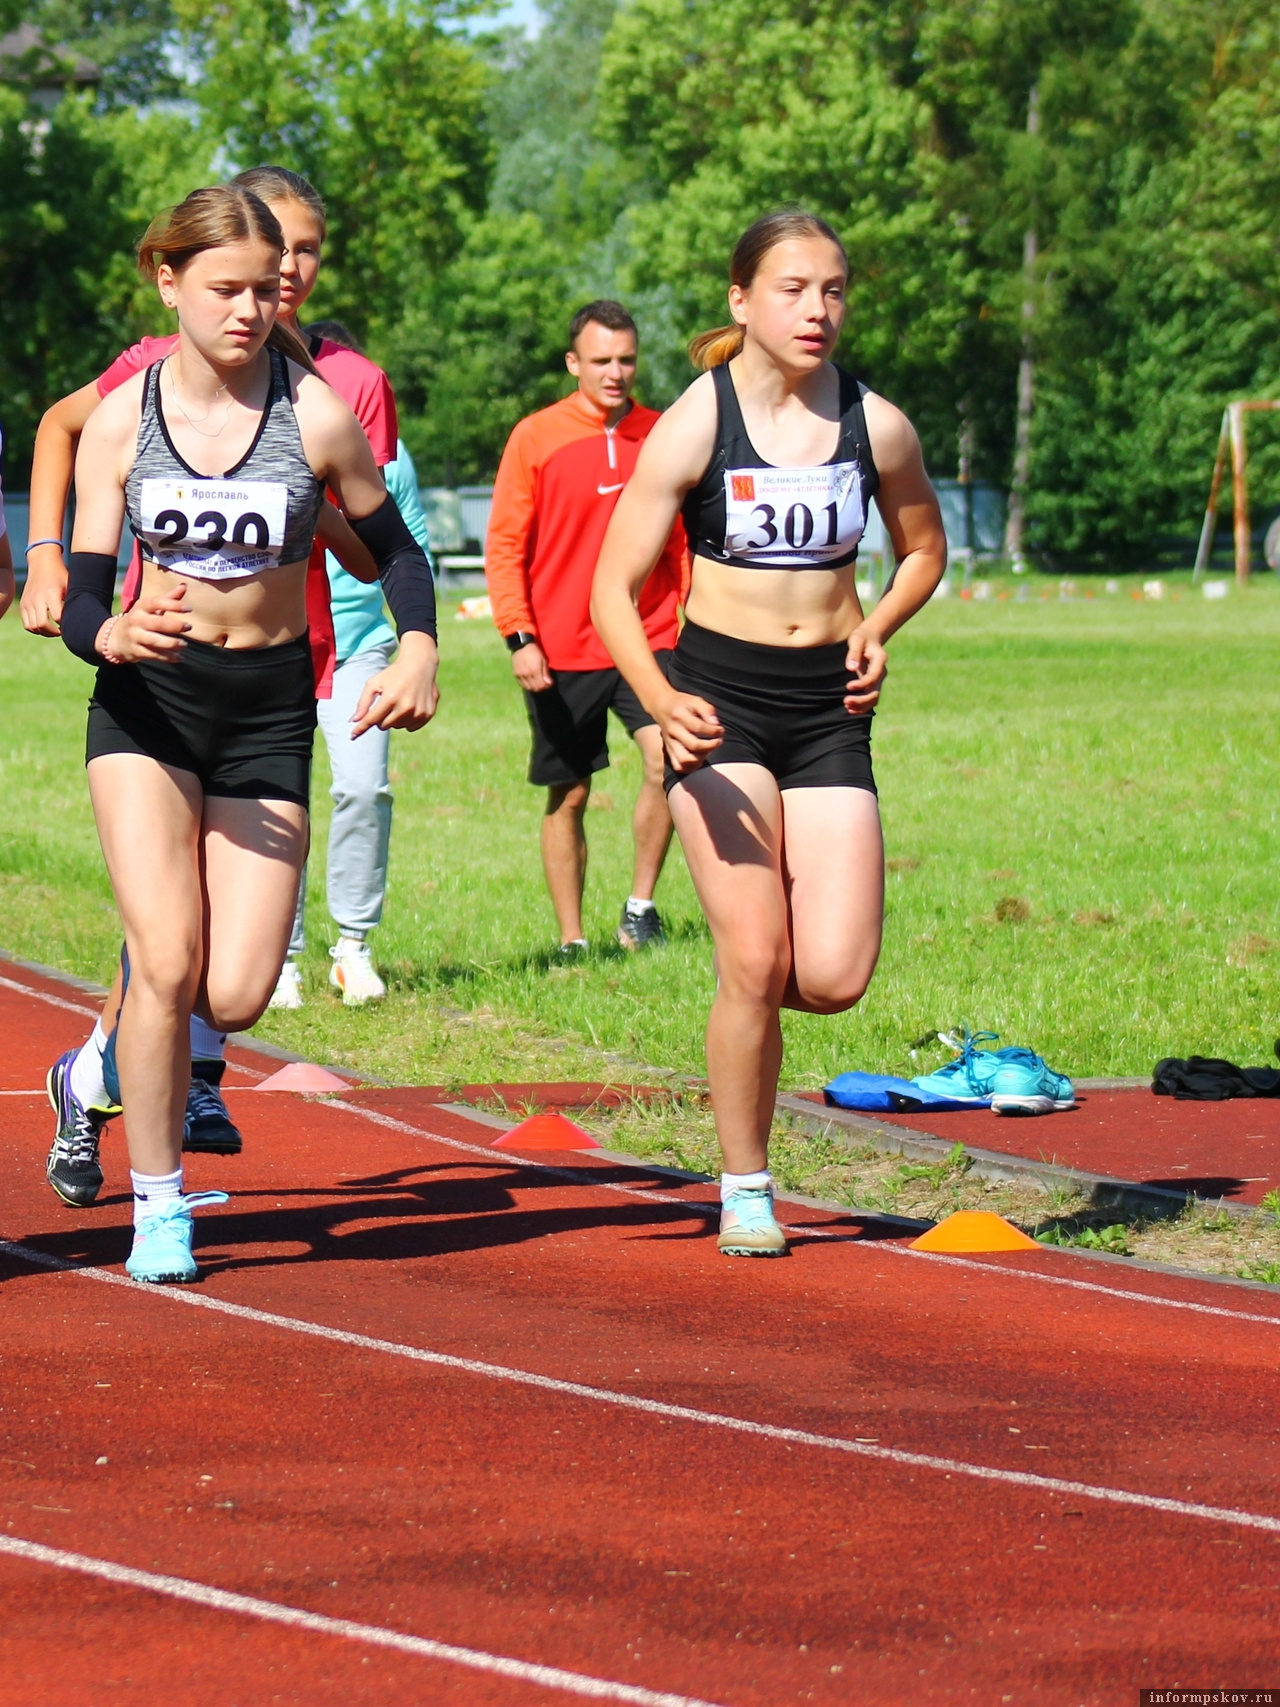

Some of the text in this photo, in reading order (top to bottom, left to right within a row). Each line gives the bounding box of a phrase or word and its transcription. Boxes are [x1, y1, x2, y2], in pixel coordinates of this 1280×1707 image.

[763, 475, 828, 485] Великие Луки
[191, 488, 249, 500] Ярославль
[154, 509, 270, 551] 230
[747, 500, 841, 549] 301
